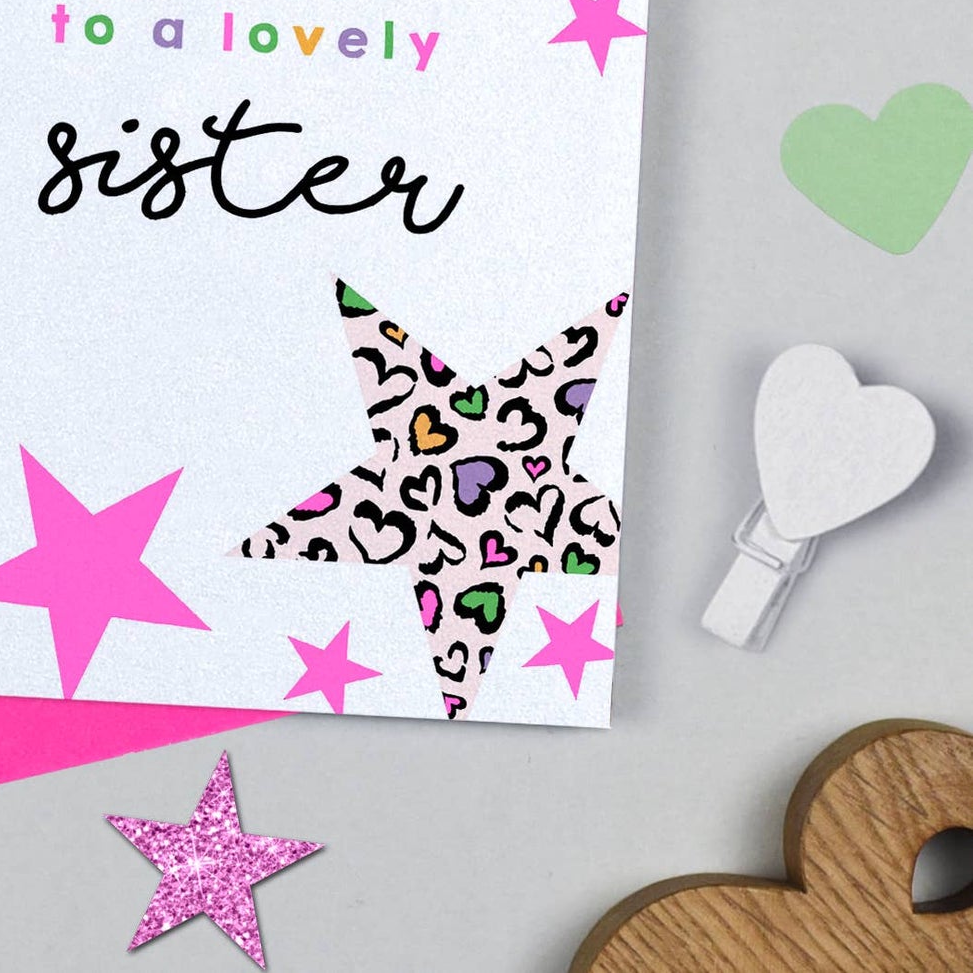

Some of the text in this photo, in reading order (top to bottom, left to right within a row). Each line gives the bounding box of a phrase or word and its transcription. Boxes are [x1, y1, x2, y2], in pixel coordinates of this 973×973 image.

[50, 3, 441, 72] to a lovely
[37, 98, 465, 235] sister
